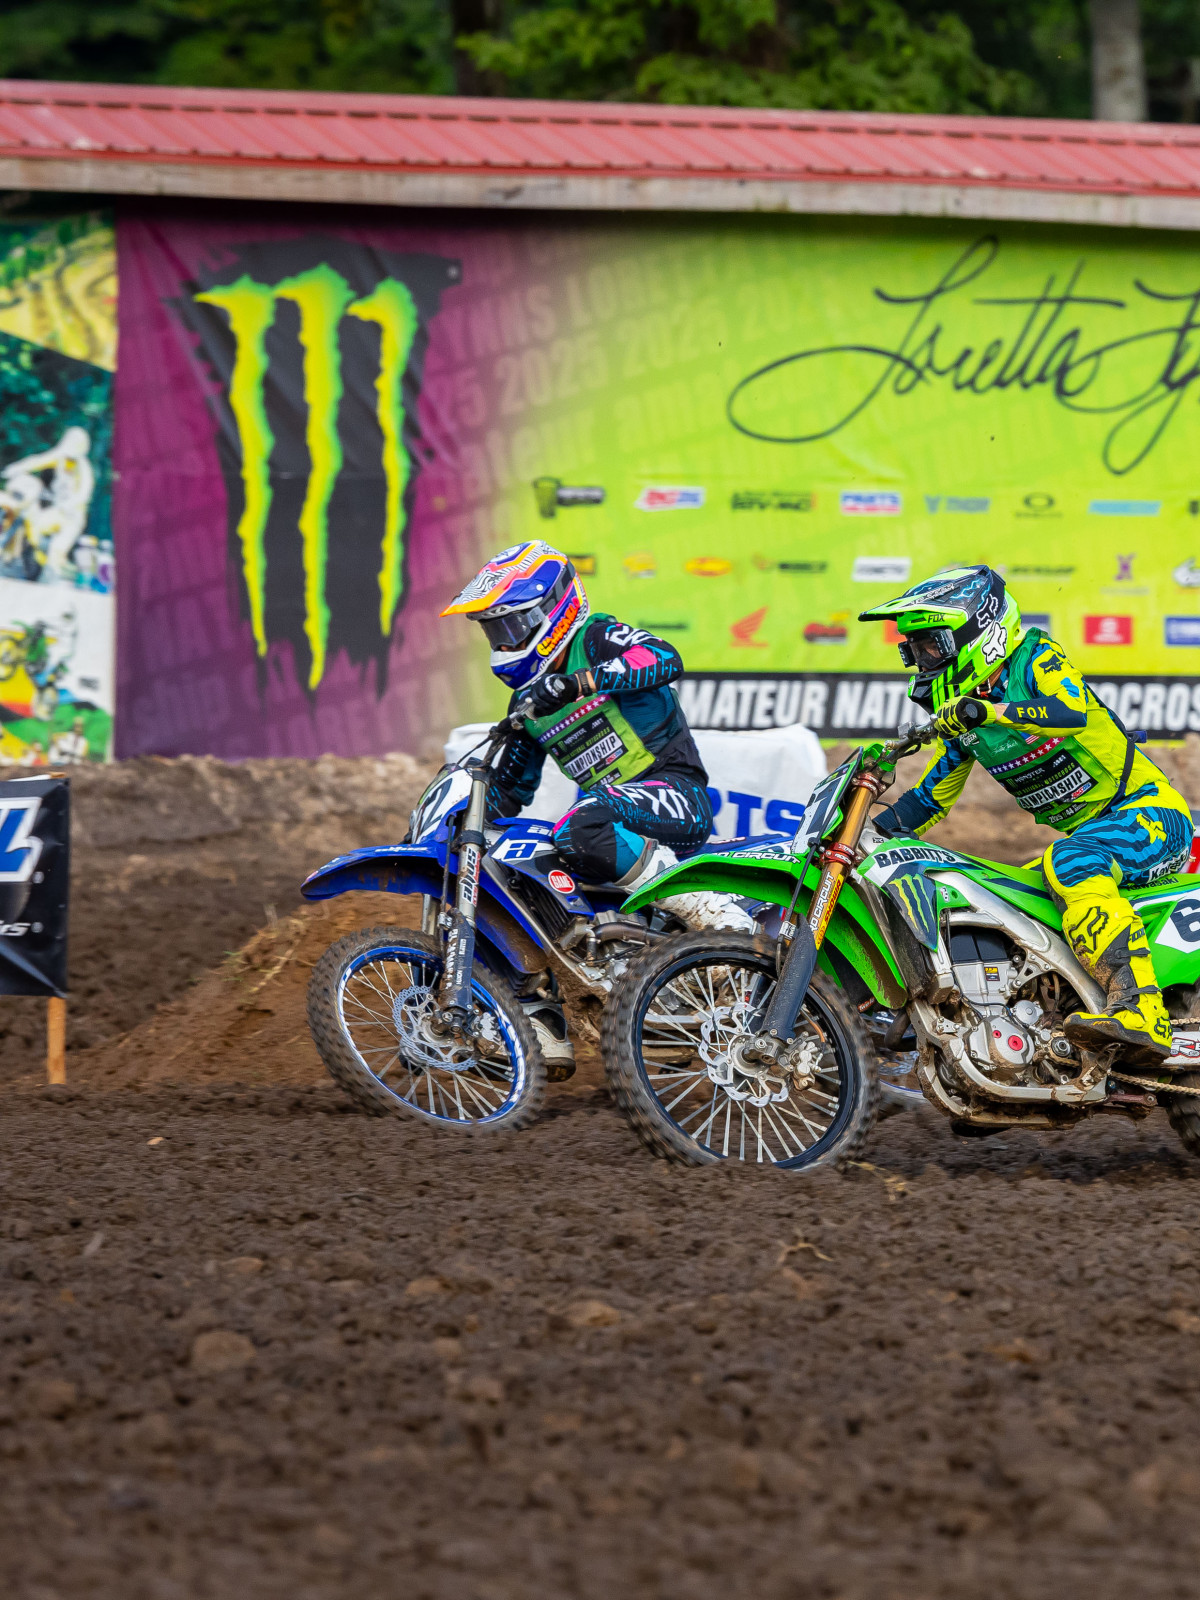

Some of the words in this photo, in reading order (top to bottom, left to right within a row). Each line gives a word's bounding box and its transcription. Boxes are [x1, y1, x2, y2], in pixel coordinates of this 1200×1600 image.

[727, 236, 1125, 443] Loretta
[928, 613, 945, 623] FOX
[676, 679, 818, 730] MATEUR
[1016, 706, 1049, 719] FOX
[732, 850, 803, 864] CIRCUIT
[874, 847, 957, 869] BABBITT'S
[550, 873, 574, 891] GAME
[815, 870, 836, 918] CIRCUIT
